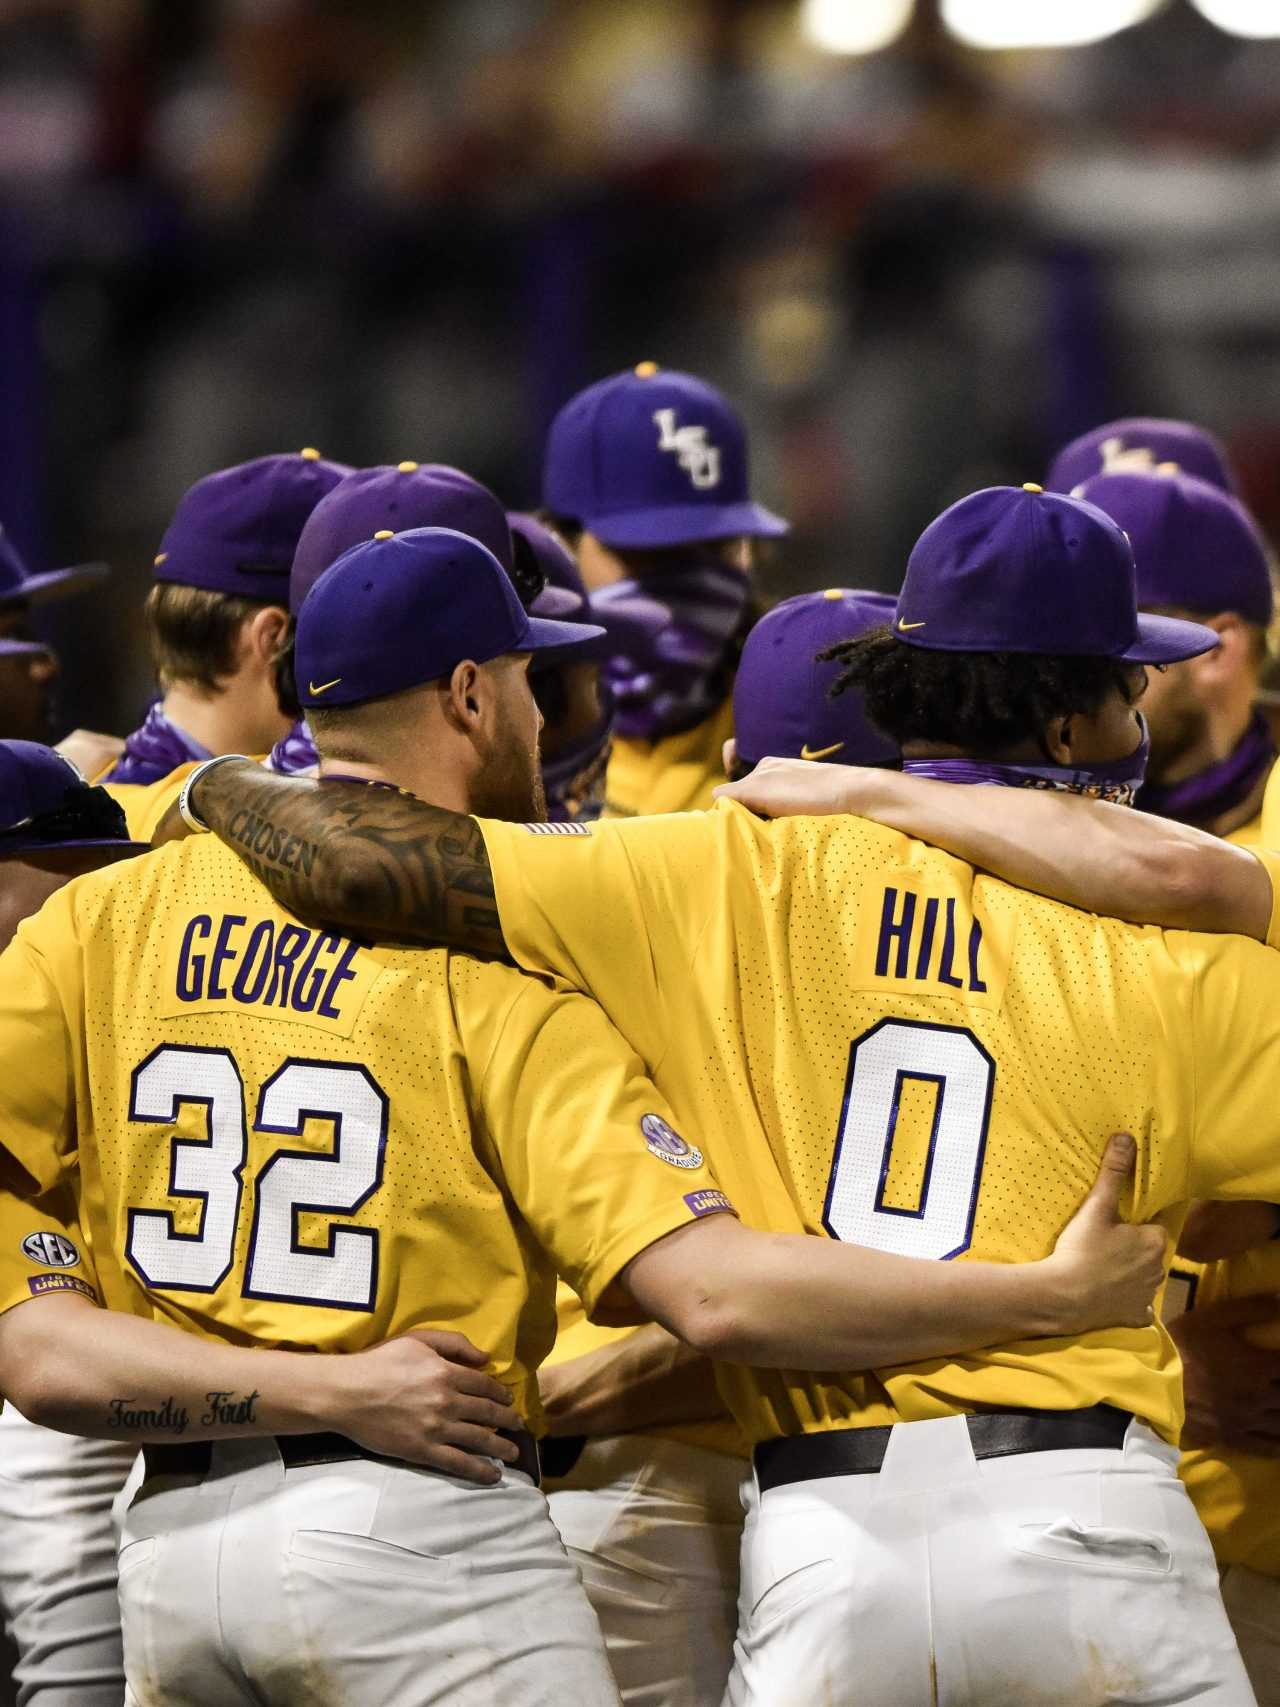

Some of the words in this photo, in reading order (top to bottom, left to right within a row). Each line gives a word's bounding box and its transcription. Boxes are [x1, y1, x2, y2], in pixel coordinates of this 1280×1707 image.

[653, 408, 721, 491] LSU
[228, 808, 320, 877] CHOSEN
[176, 914, 376, 1020] GEORGE
[875, 886, 988, 993] HILL
[124, 1042, 390, 1313] 32
[821, 1015, 996, 1262] 0
[25, 1232, 77, 1266] SEC
[108, 1396, 189, 1434] Family
[201, 1389, 260, 1425] First
